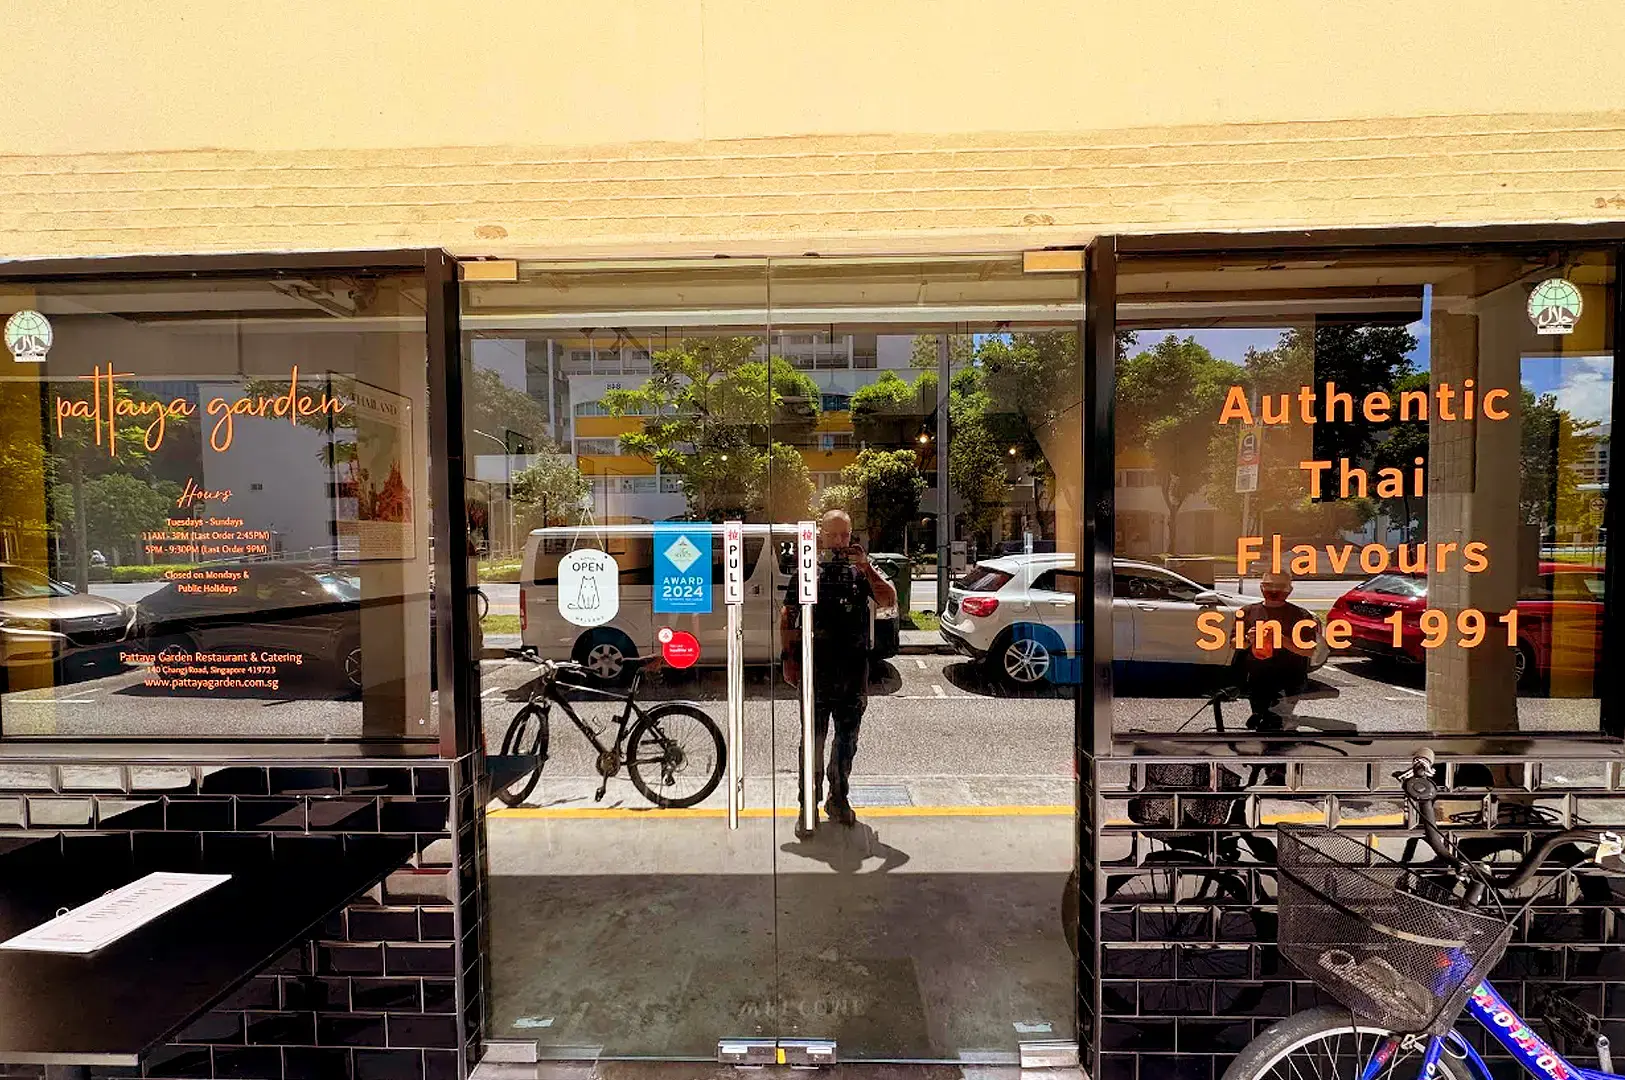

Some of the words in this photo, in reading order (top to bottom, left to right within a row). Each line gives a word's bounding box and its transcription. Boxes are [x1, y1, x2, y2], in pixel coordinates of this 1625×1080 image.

[55, 361, 196, 456] pattaya
[207, 364, 347, 453] garden
[1218, 379, 1511, 426] Authentic
[1299, 457, 1426, 499] Thai
[177, 477, 233, 509] Hours
[166, 517, 203, 528] Tuesdays
[210, 517, 244, 528] Sundays
[142, 531, 166, 540] 11AM
[172, 531, 189, 540] 3PM
[191, 531, 211, 540] (Last
[212, 531, 234, 540] Order
[236, 531, 270, 540] 2:45PM)
[145, 545, 163, 554] 5PM
[169, 545, 200, 554] 9:30PM
[201, 545, 220, 554] (Last
[222, 545, 244, 554] Order
[245, 545, 267, 554] 9PM)
[1236, 534, 1489, 576] Flavours
[572, 562, 604, 572] OPEN
[729, 545, 738, 596] PULL
[803, 545, 812, 596] PULL
[164, 570, 192, 580] Closed
[206, 570, 242, 580] Mondays
[243, 570, 249, 580] &
[663, 576, 704, 585] AWARD
[178, 583, 202, 594] Public
[203, 583, 238, 594] Holidays
[662, 586, 704, 597] 2024
[1195, 610, 1354, 651] Since
[1384, 608, 1519, 650] 1991
[119, 652, 155, 663] Pattaya
[158, 652, 193, 663] Garden
[195, 652, 248, 663] Restaurant
[250, 652, 258, 663] &
[260, 652, 303, 664] Catering
[162, 666, 188, 675] Changi
[210, 666, 246, 675] Singapore
[247, 666, 277, 674] 419723
[144, 677, 279, 690] www.pattayagarden.com.sg
